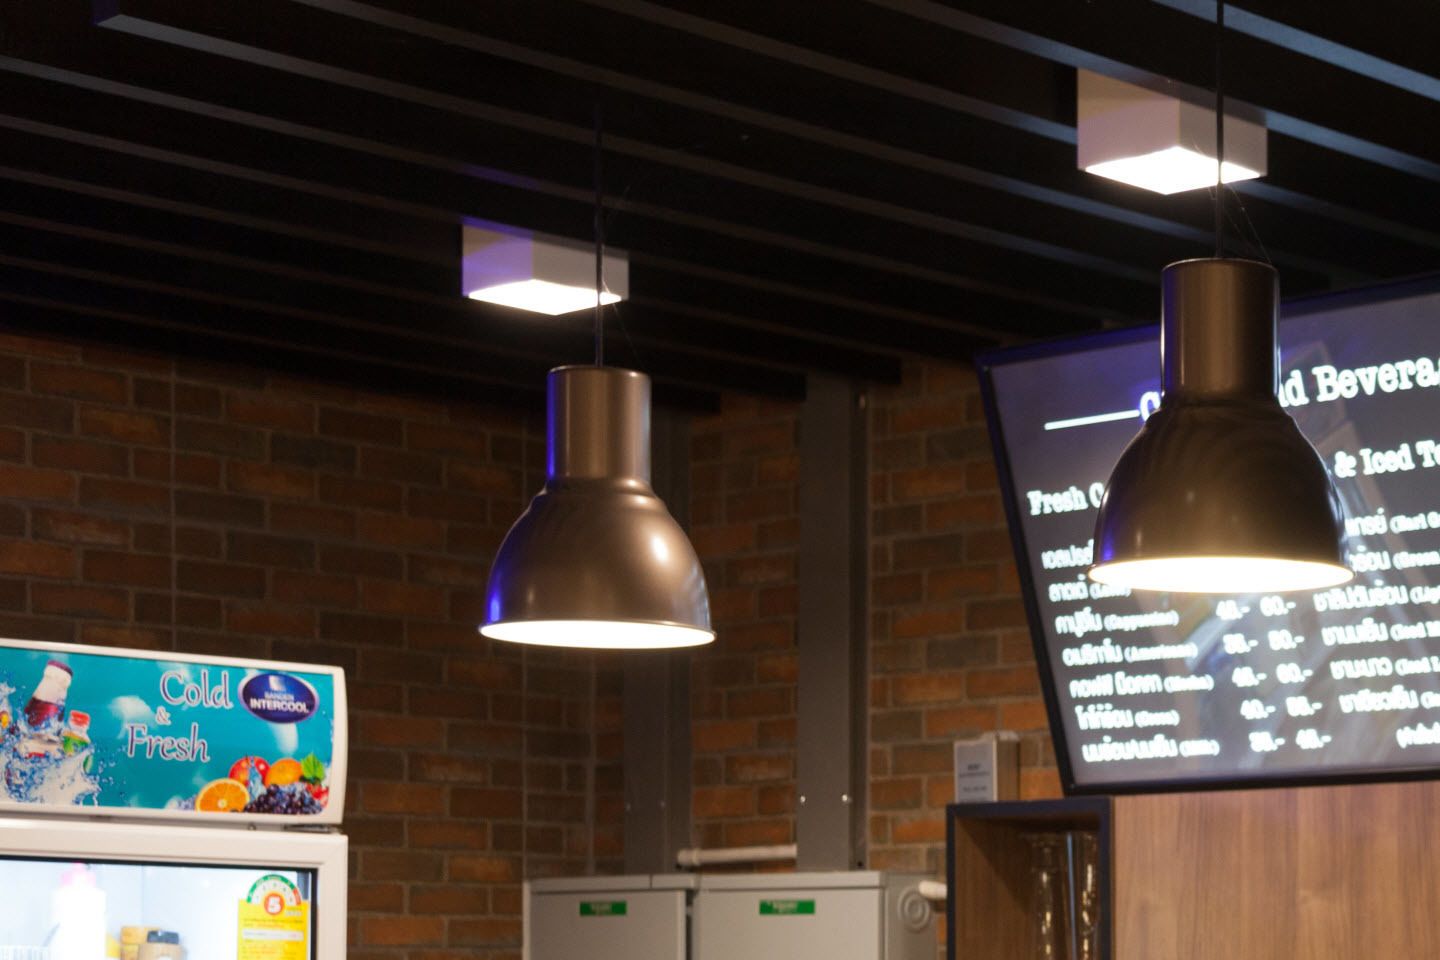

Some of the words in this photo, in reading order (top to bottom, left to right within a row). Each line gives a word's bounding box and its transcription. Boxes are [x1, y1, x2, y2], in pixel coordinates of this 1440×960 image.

[1334, 450, 1357, 478] &
[1359, 443, 1415, 475] Iced
[1026, 486, 1088, 515] Fresh
[160, 669, 233, 708] Cold
[155, 706, 171, 725] &
[250, 697, 309, 714] INTERCOOL
[126, 723, 210, 762] Fresh
[267, 895, 282, 913] 5
